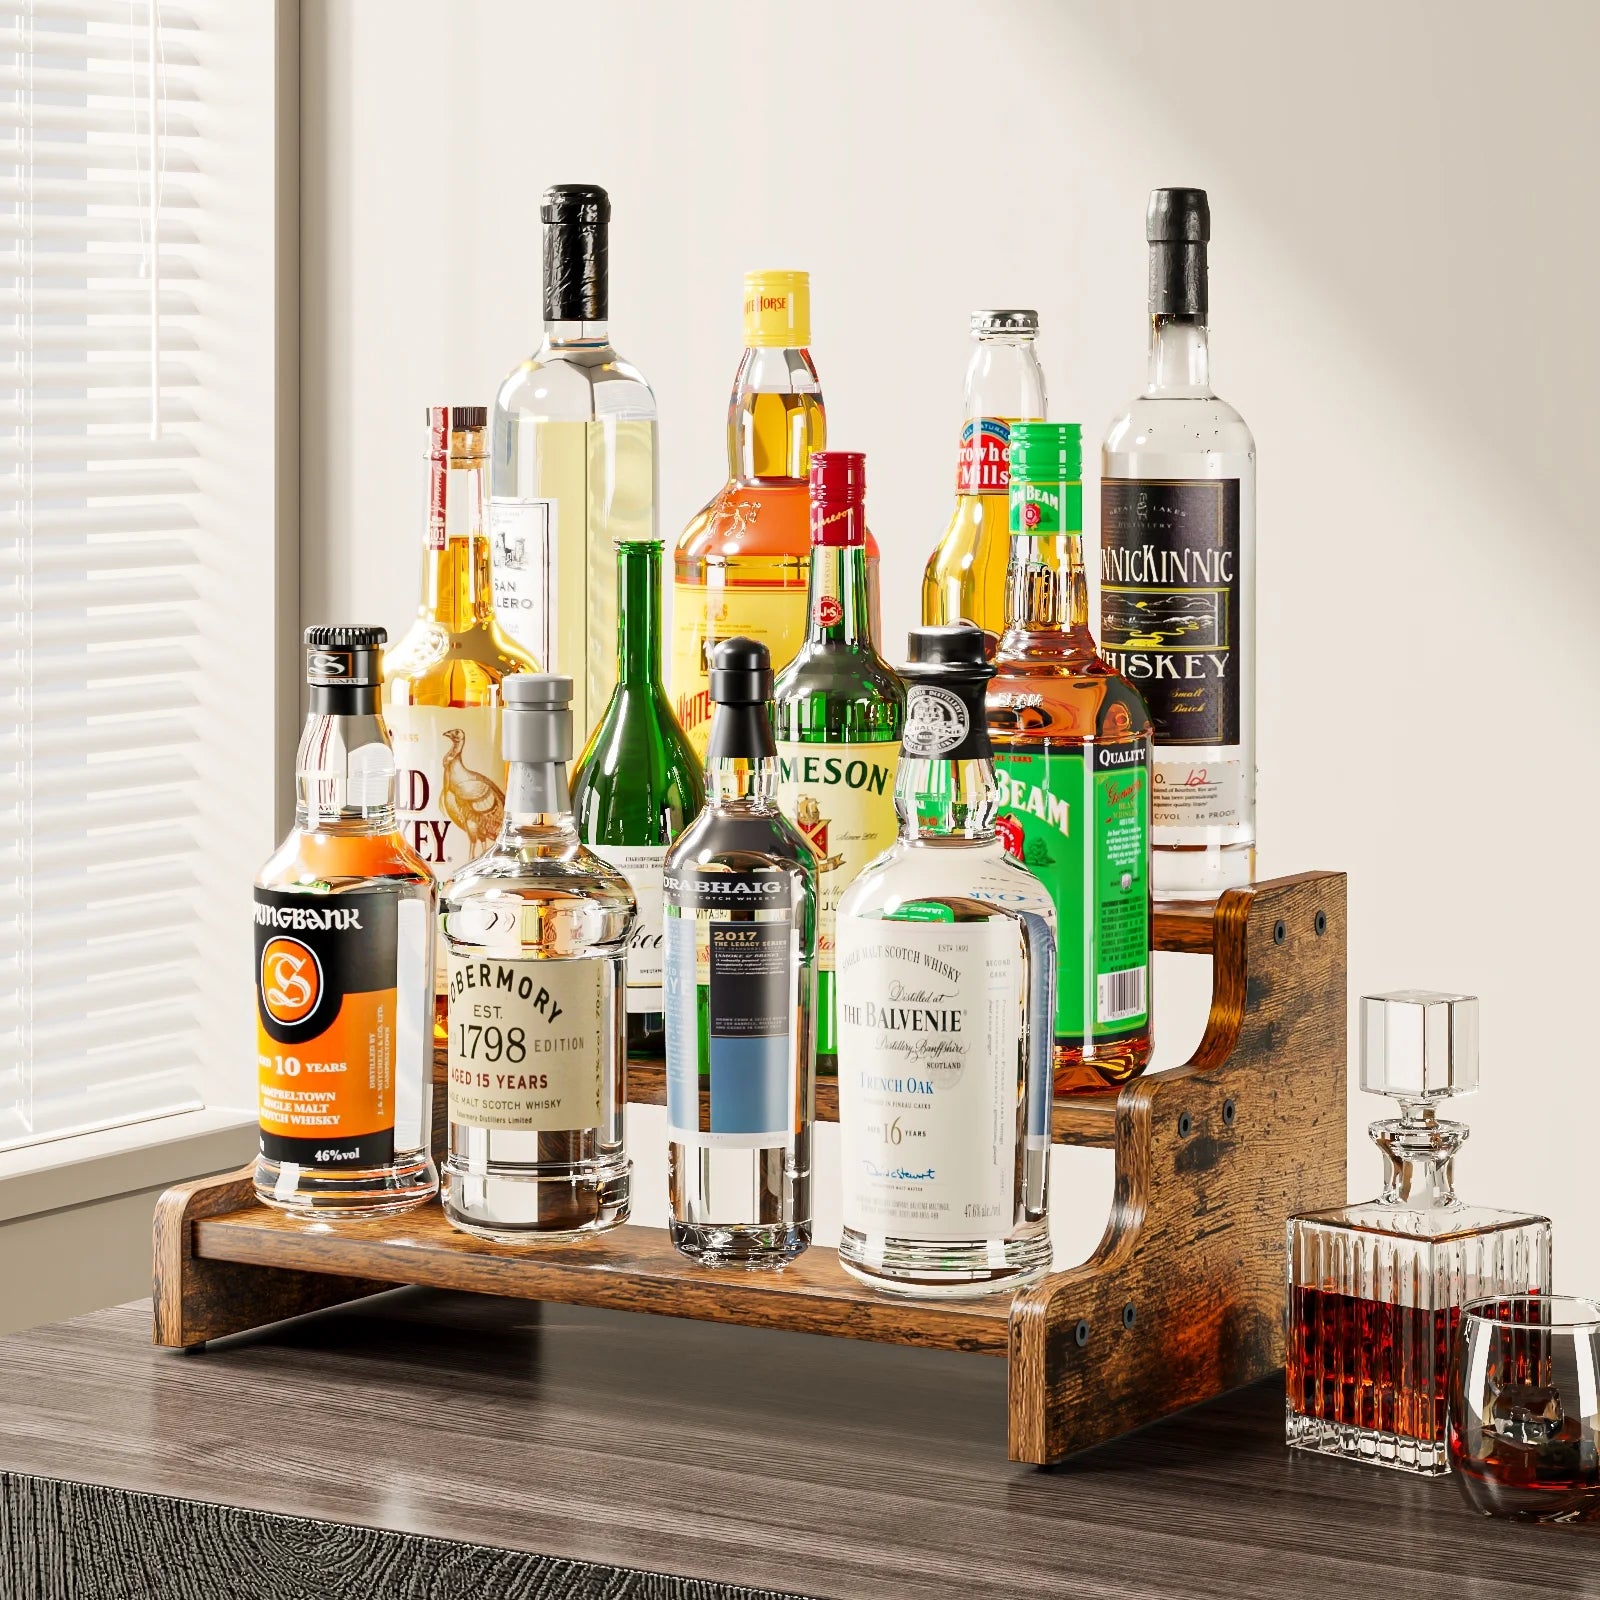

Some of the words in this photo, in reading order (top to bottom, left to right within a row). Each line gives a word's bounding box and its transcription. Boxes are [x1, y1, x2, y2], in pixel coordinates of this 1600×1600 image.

[961, 465, 1010, 485] Mills
[1026, 484, 1059, 511] BEAM
[1100, 544, 1233, 583] NNICKINNIC
[1099, 748, 1146, 767] QUALITY
[779, 757, 889, 796] MESON
[1154, 773, 1166, 784] O.
[395, 769, 430, 811] LD
[662, 876, 782, 894] ORABHAIG
[713, 931, 757, 941] 2017
[884, 945, 921, 964] SCOTCH
[923, 953, 962, 984] WHISKY
[449, 963, 563, 1025] OBERMORY
[888, 979, 934, 1003] Distilled
[473, 1004, 504, 1020] EST.
[843, 1004, 862, 1026] THE
[865, 1001, 963, 1033] BALVENIE
[459, 1022, 527, 1063] 1798
[534, 1037, 584, 1053] EDITION
[275, 1056, 301, 1077] 10
[305, 1062, 347, 1073] YEARS
[926, 1062, 962, 1070] SCOTLAND
[476, 1072, 490, 1088] 15
[496, 1074, 548, 1090] YEARS
[907, 1077, 934, 1095] OAK
[294, 1103, 330, 1114] MALT
[482, 1100, 521, 1111] SCOTCH
[525, 1099, 562, 1110] WHISKY
[291, 1115, 341, 1126] WHISKY
[479, 1114, 506, 1124] Distillers
[508, 1116, 533, 1125] Limited
[883, 1116, 902, 1146] 16
[905, 1130, 927, 1138] YEARS
[314, 1147, 361, 1162] 46%vol
